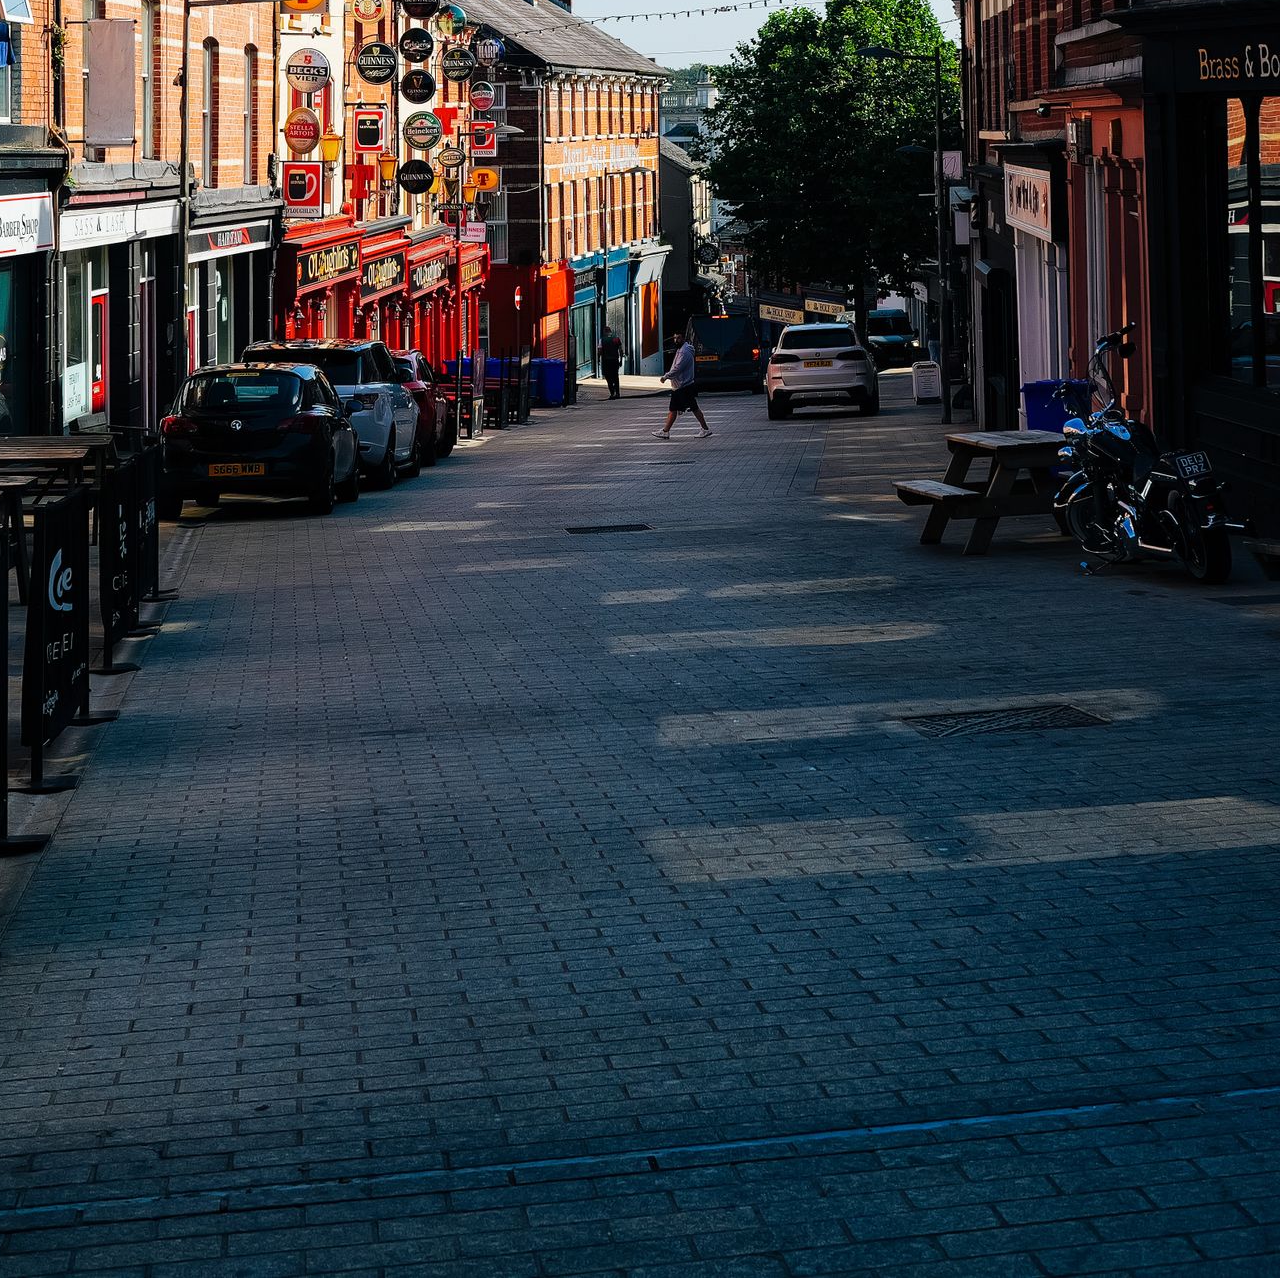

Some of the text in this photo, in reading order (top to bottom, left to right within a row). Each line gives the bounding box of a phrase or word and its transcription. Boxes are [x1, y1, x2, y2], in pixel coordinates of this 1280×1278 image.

[358, 56, 395, 66] GUINNESS
[443, 60, 473, 68] GUINNESS
[1198, 47, 1240, 81] Brass
[1244, 44, 1255, 79] &
[295, 75, 319, 83] VIER
[290, 124, 314, 132] STELLA
[407, 127, 439, 136] Heineken
[400, 173, 433, 182] GUINNESS
[477, 173, 489, 186] T
[21, 213, 40, 236] SHOP
[73, 213, 128, 237] SASS & LASH
[1180, 453, 1204, 467] DE13
[214, 464, 239, 475] SG66
[1184, 463, 1207, 475] PRZ
